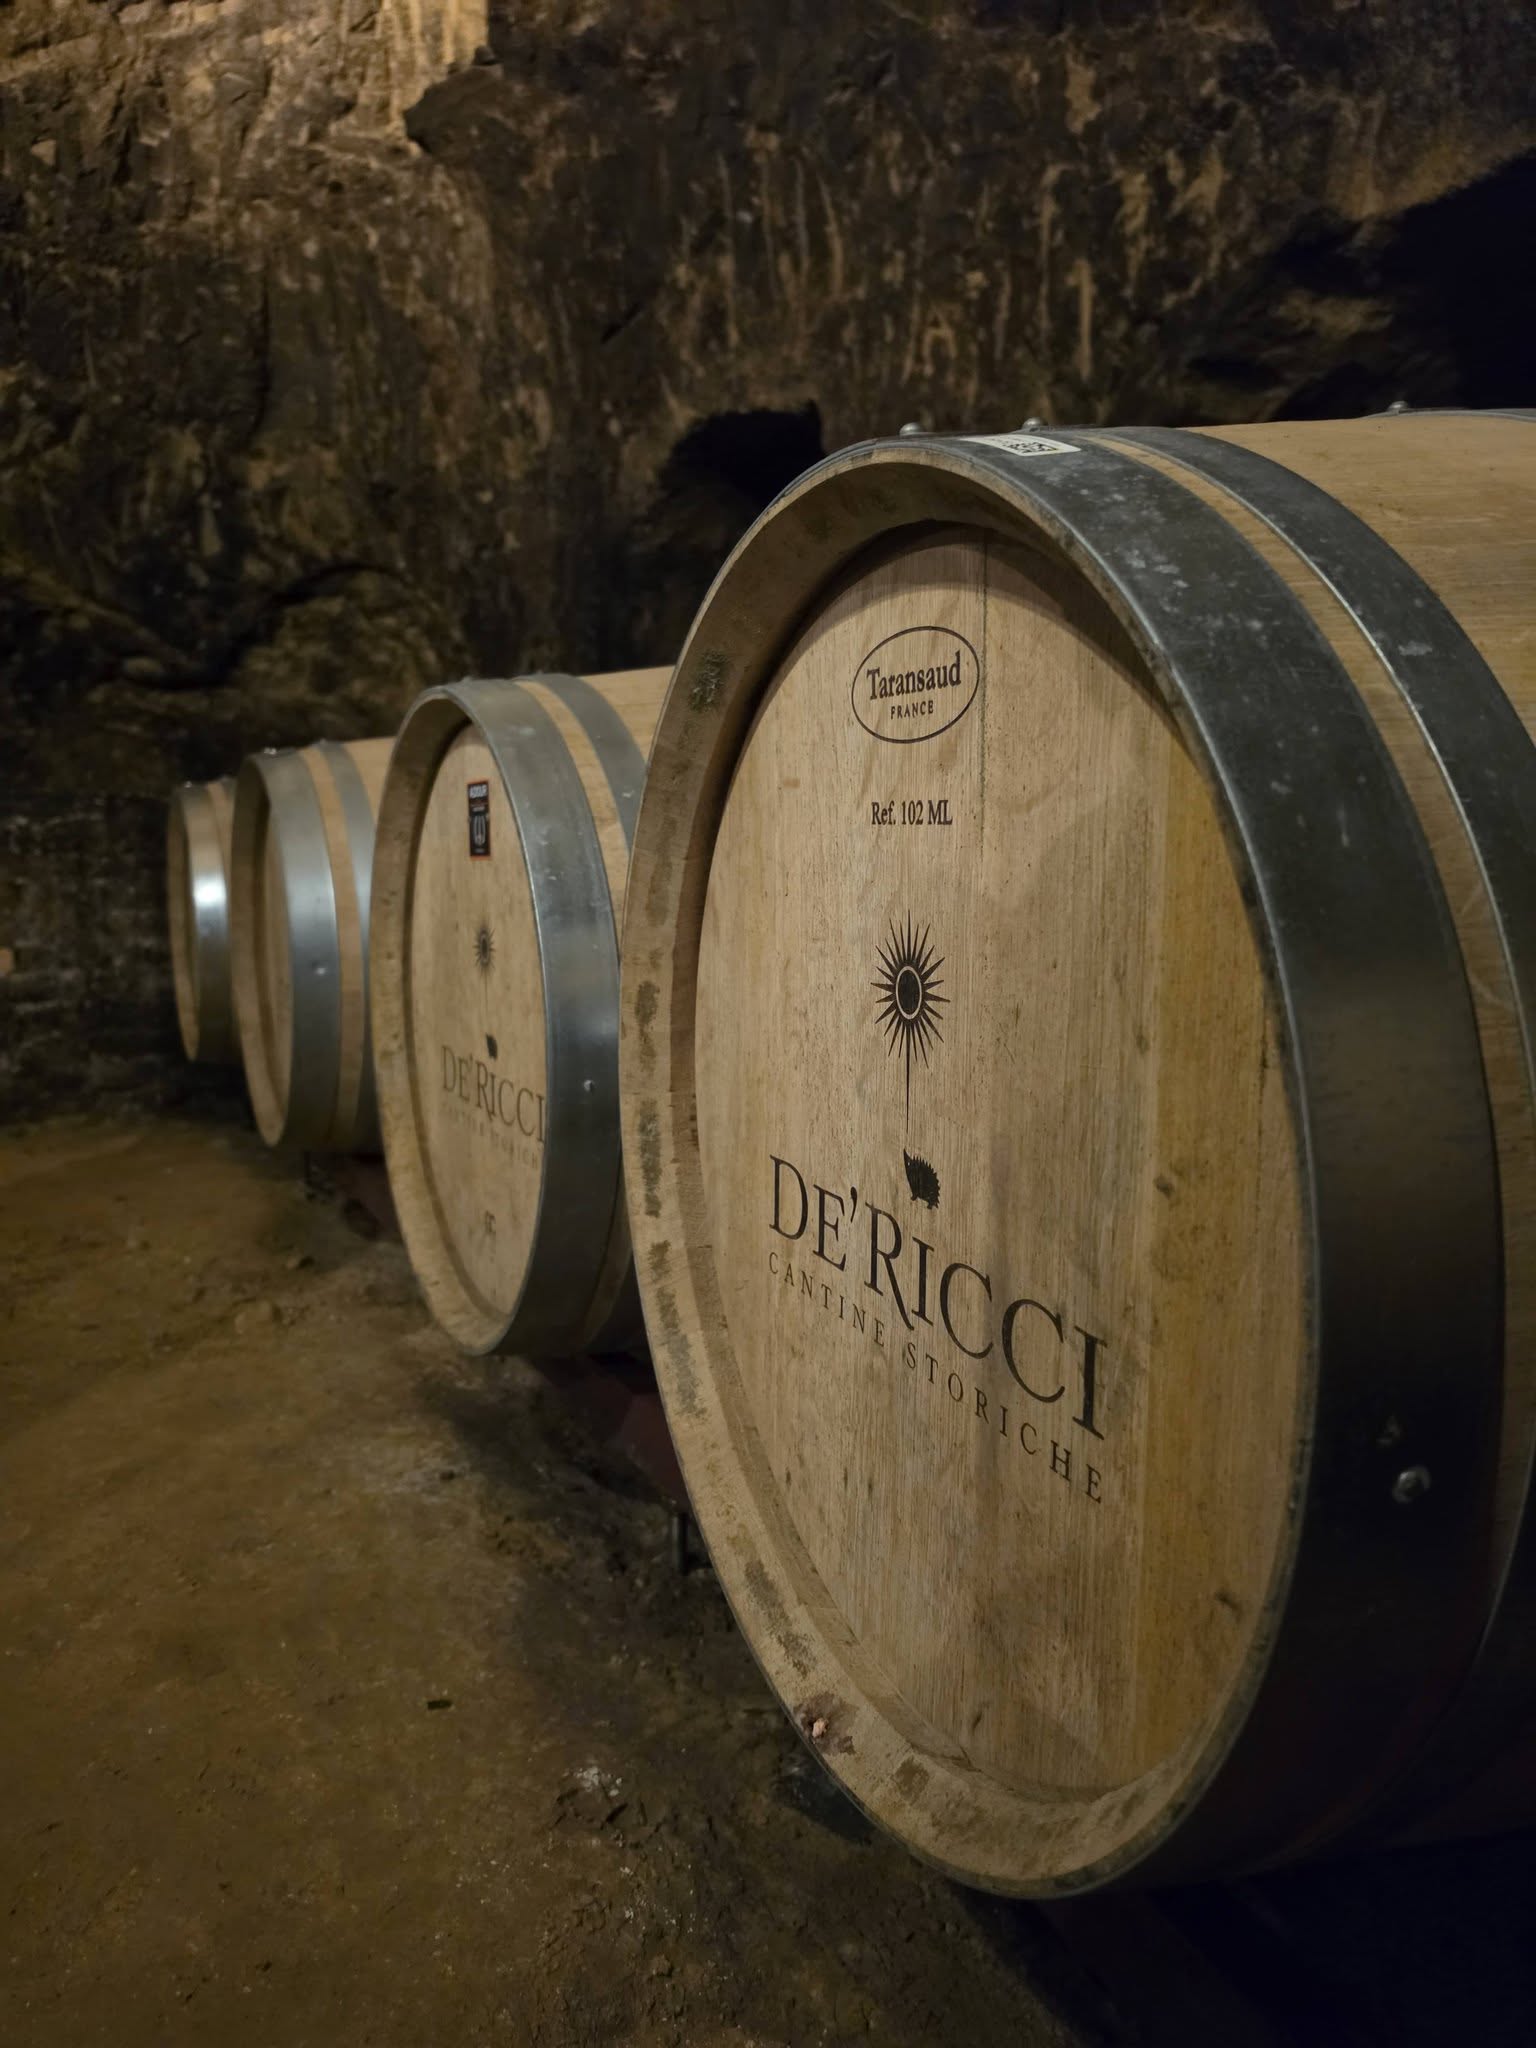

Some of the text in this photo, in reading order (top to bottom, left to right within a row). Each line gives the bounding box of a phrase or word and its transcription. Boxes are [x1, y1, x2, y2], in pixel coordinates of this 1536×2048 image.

[866, 648, 962, 700] Taransaud
[890, 700, 934, 720] FRANCE
[871, 799, 953, 825] Ref. 102 ML
[768, 1251, 1102, 1504] CANTINE STORICHE
